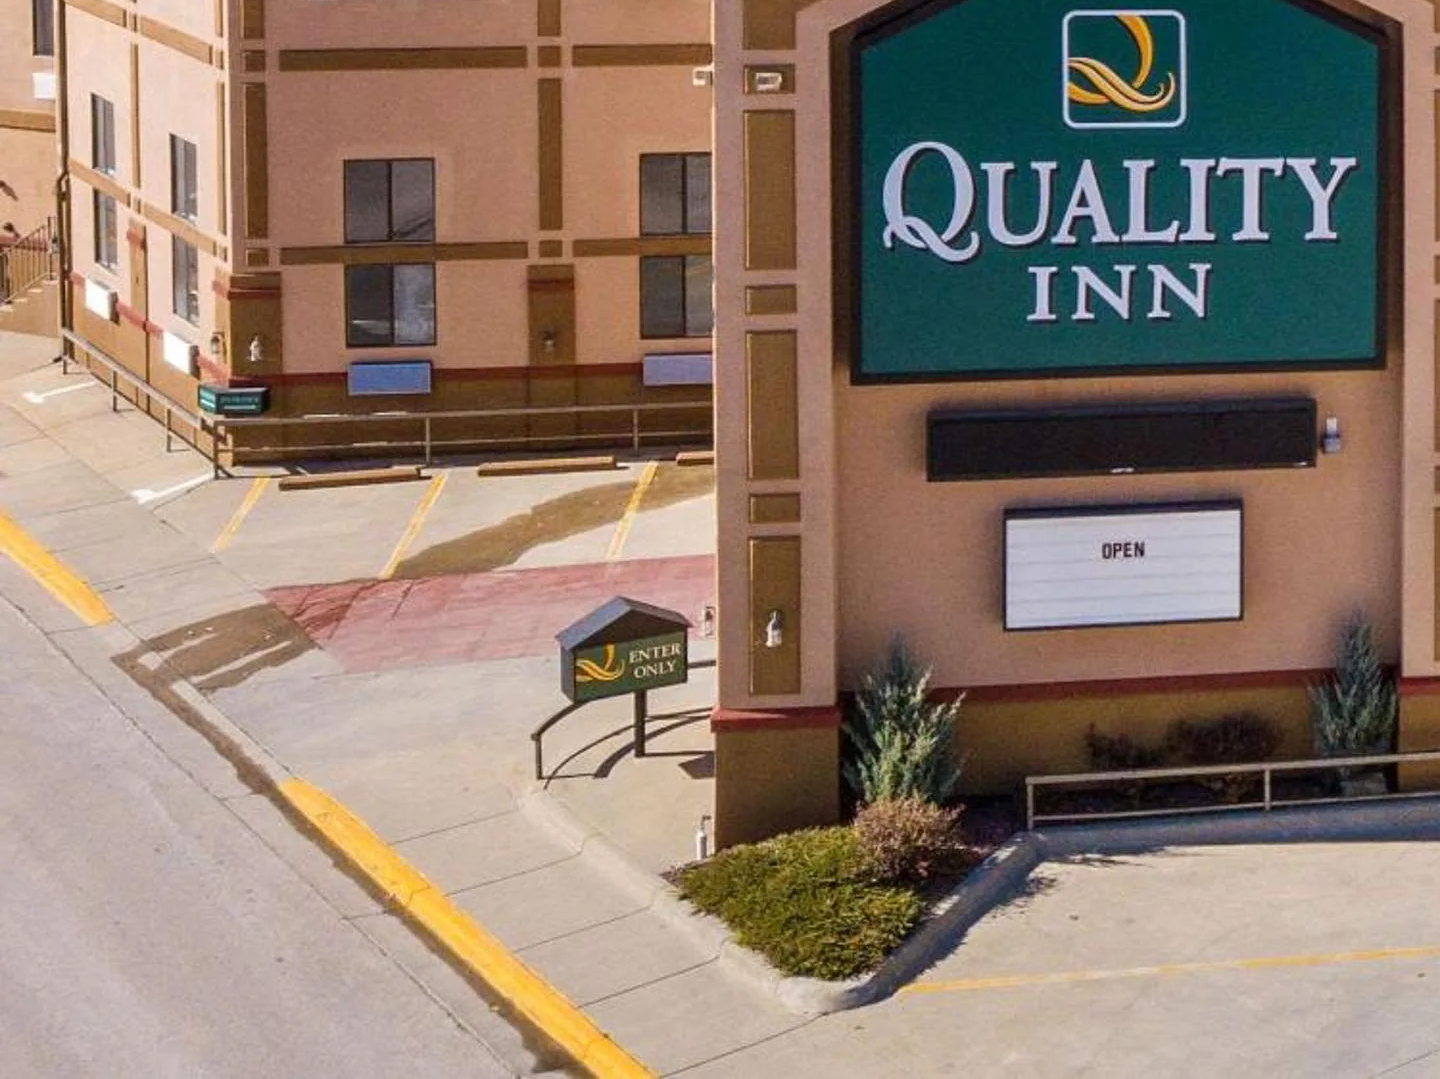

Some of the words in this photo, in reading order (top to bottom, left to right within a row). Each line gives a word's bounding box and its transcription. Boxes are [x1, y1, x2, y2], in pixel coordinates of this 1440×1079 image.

[882, 140, 1357, 263] QUALITY
[1026, 263, 1212, 322] INN
[1101, 541, 1146, 559] OPEN
[629, 642, 681, 664] ENTER
[633, 660, 677, 679] ONLY
